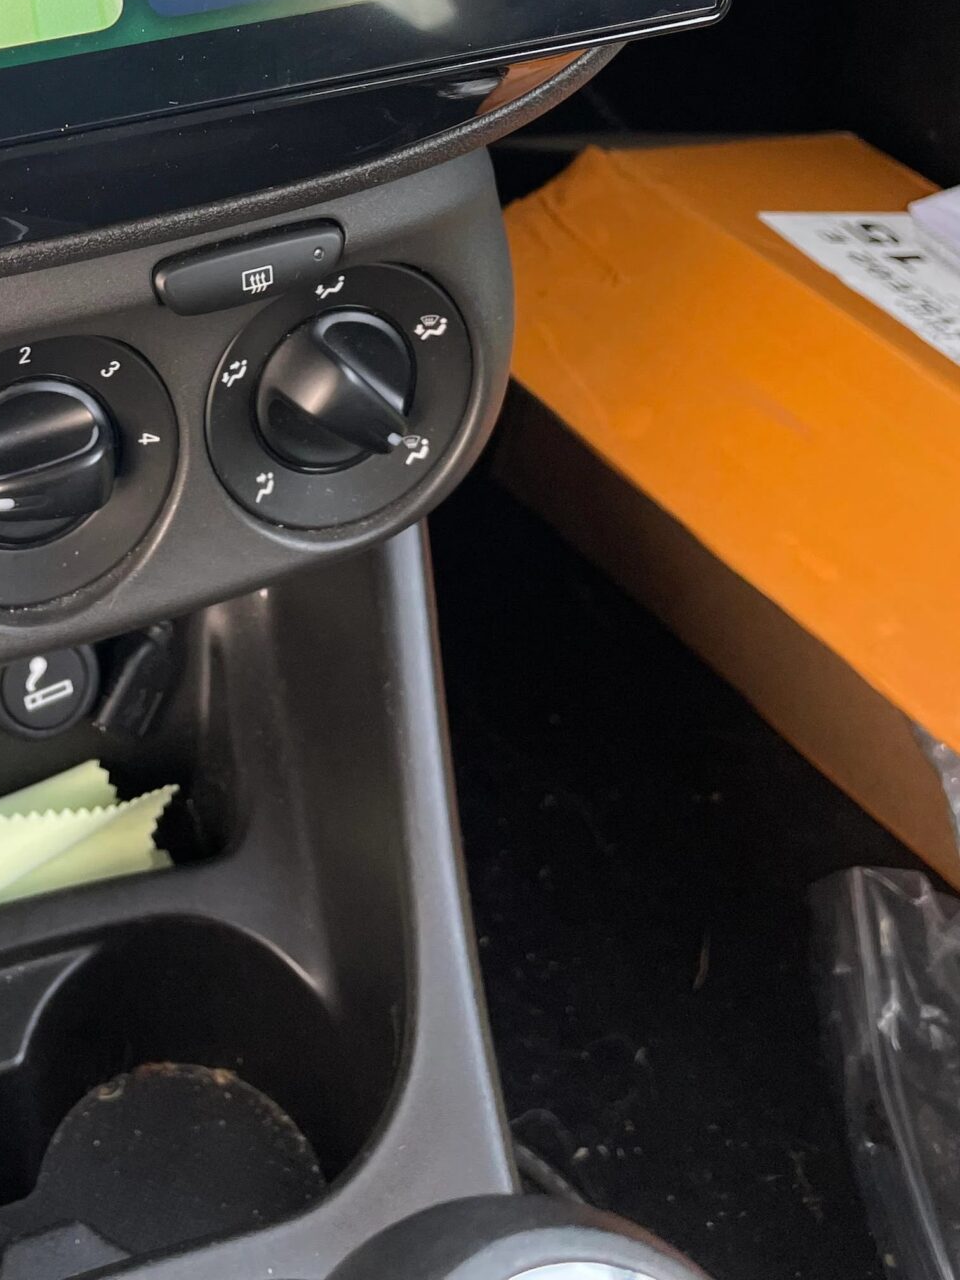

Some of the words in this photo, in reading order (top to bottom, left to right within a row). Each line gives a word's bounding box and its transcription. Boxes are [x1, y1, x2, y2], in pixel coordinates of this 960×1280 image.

[18, 346, 32, 365] 2
[100, 360, 121, 377] 3
[137, 432, 161, 446] 4
